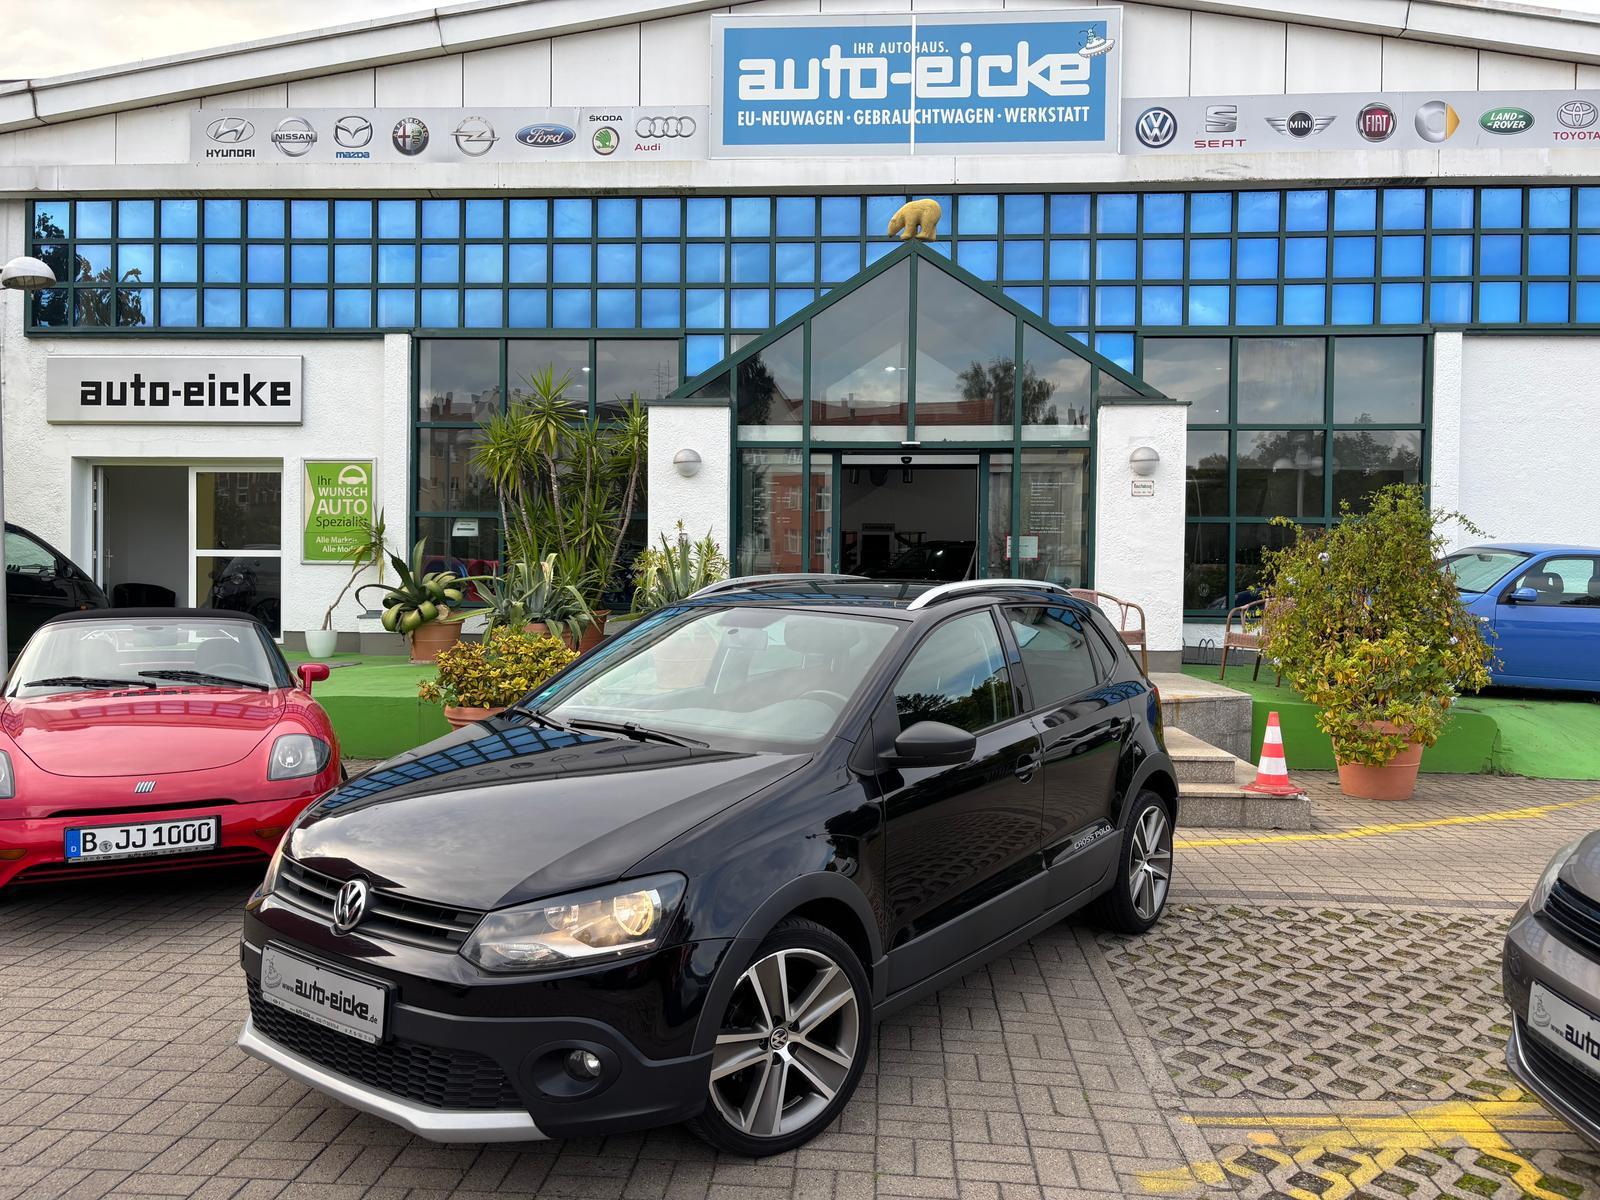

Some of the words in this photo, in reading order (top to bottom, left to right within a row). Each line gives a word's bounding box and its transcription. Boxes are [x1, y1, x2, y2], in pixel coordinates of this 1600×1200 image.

[853, 42, 874, 55] IHR
[879, 41, 949, 54] AUTOHAUS.
[738, 40, 1091, 101] auto-eicke
[737, 109, 844, 126] EU-NEUWAGEN
[853, 107, 994, 125] GEBRAUCHTWAGEN
[1004, 106, 1090, 123] WERKSTATT
[1490, 112, 1517, 121] LAND
[1289, 120, 1312, 129] MINI
[1365, 113, 1388, 132] FIAT
[1492, 120, 1526, 129] ROVER
[525, 127, 565, 143] Ford
[1553, 131, 1600, 141] TOYOTA
[634, 143, 661, 151] Audi
[1194, 139, 1247, 148] SEAT
[206, 149, 256, 158] HYUNDAI
[80, 373, 291, 406] auto-eicke
[317, 474, 332, 486] Ihr
[318, 486, 368, 497] WUNSCH
[315, 498, 368, 515] AUTO
[82, 831, 98, 853] B
